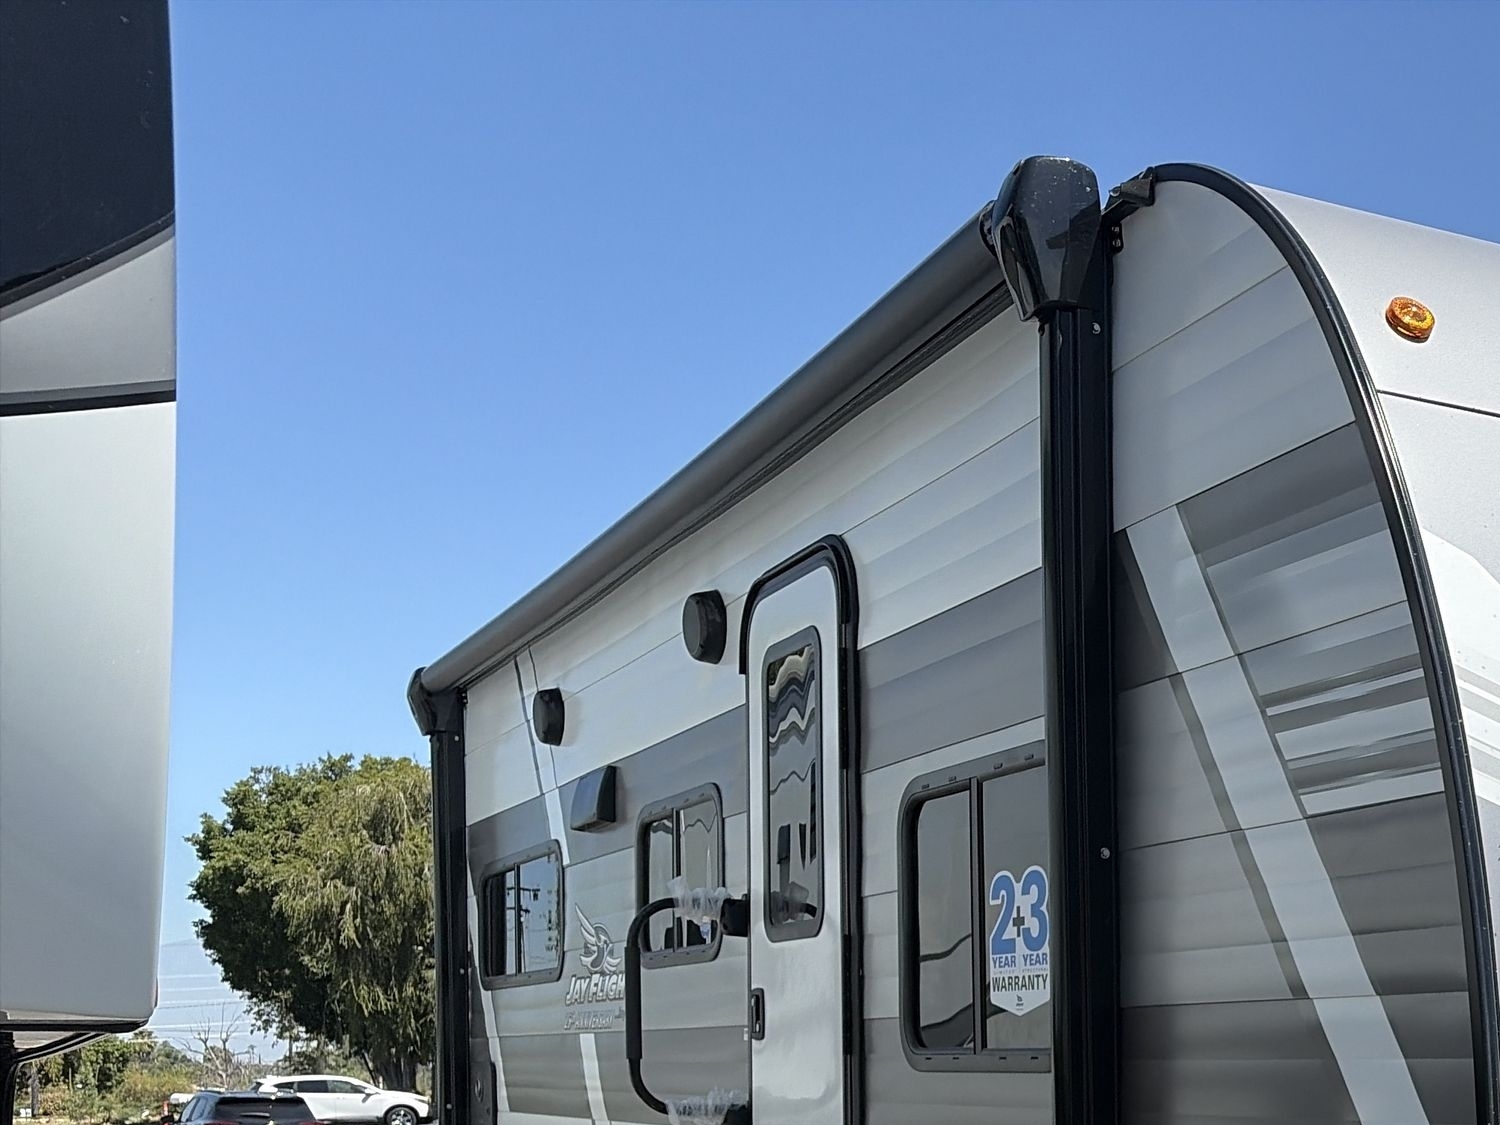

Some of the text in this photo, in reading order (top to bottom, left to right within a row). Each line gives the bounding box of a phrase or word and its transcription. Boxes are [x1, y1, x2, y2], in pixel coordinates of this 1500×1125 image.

[992, 952, 1048, 969] YEAR YEAR
[565, 971, 626, 1006] JAY FLIGH
[992, 974, 1048, 992] WARRANTY
